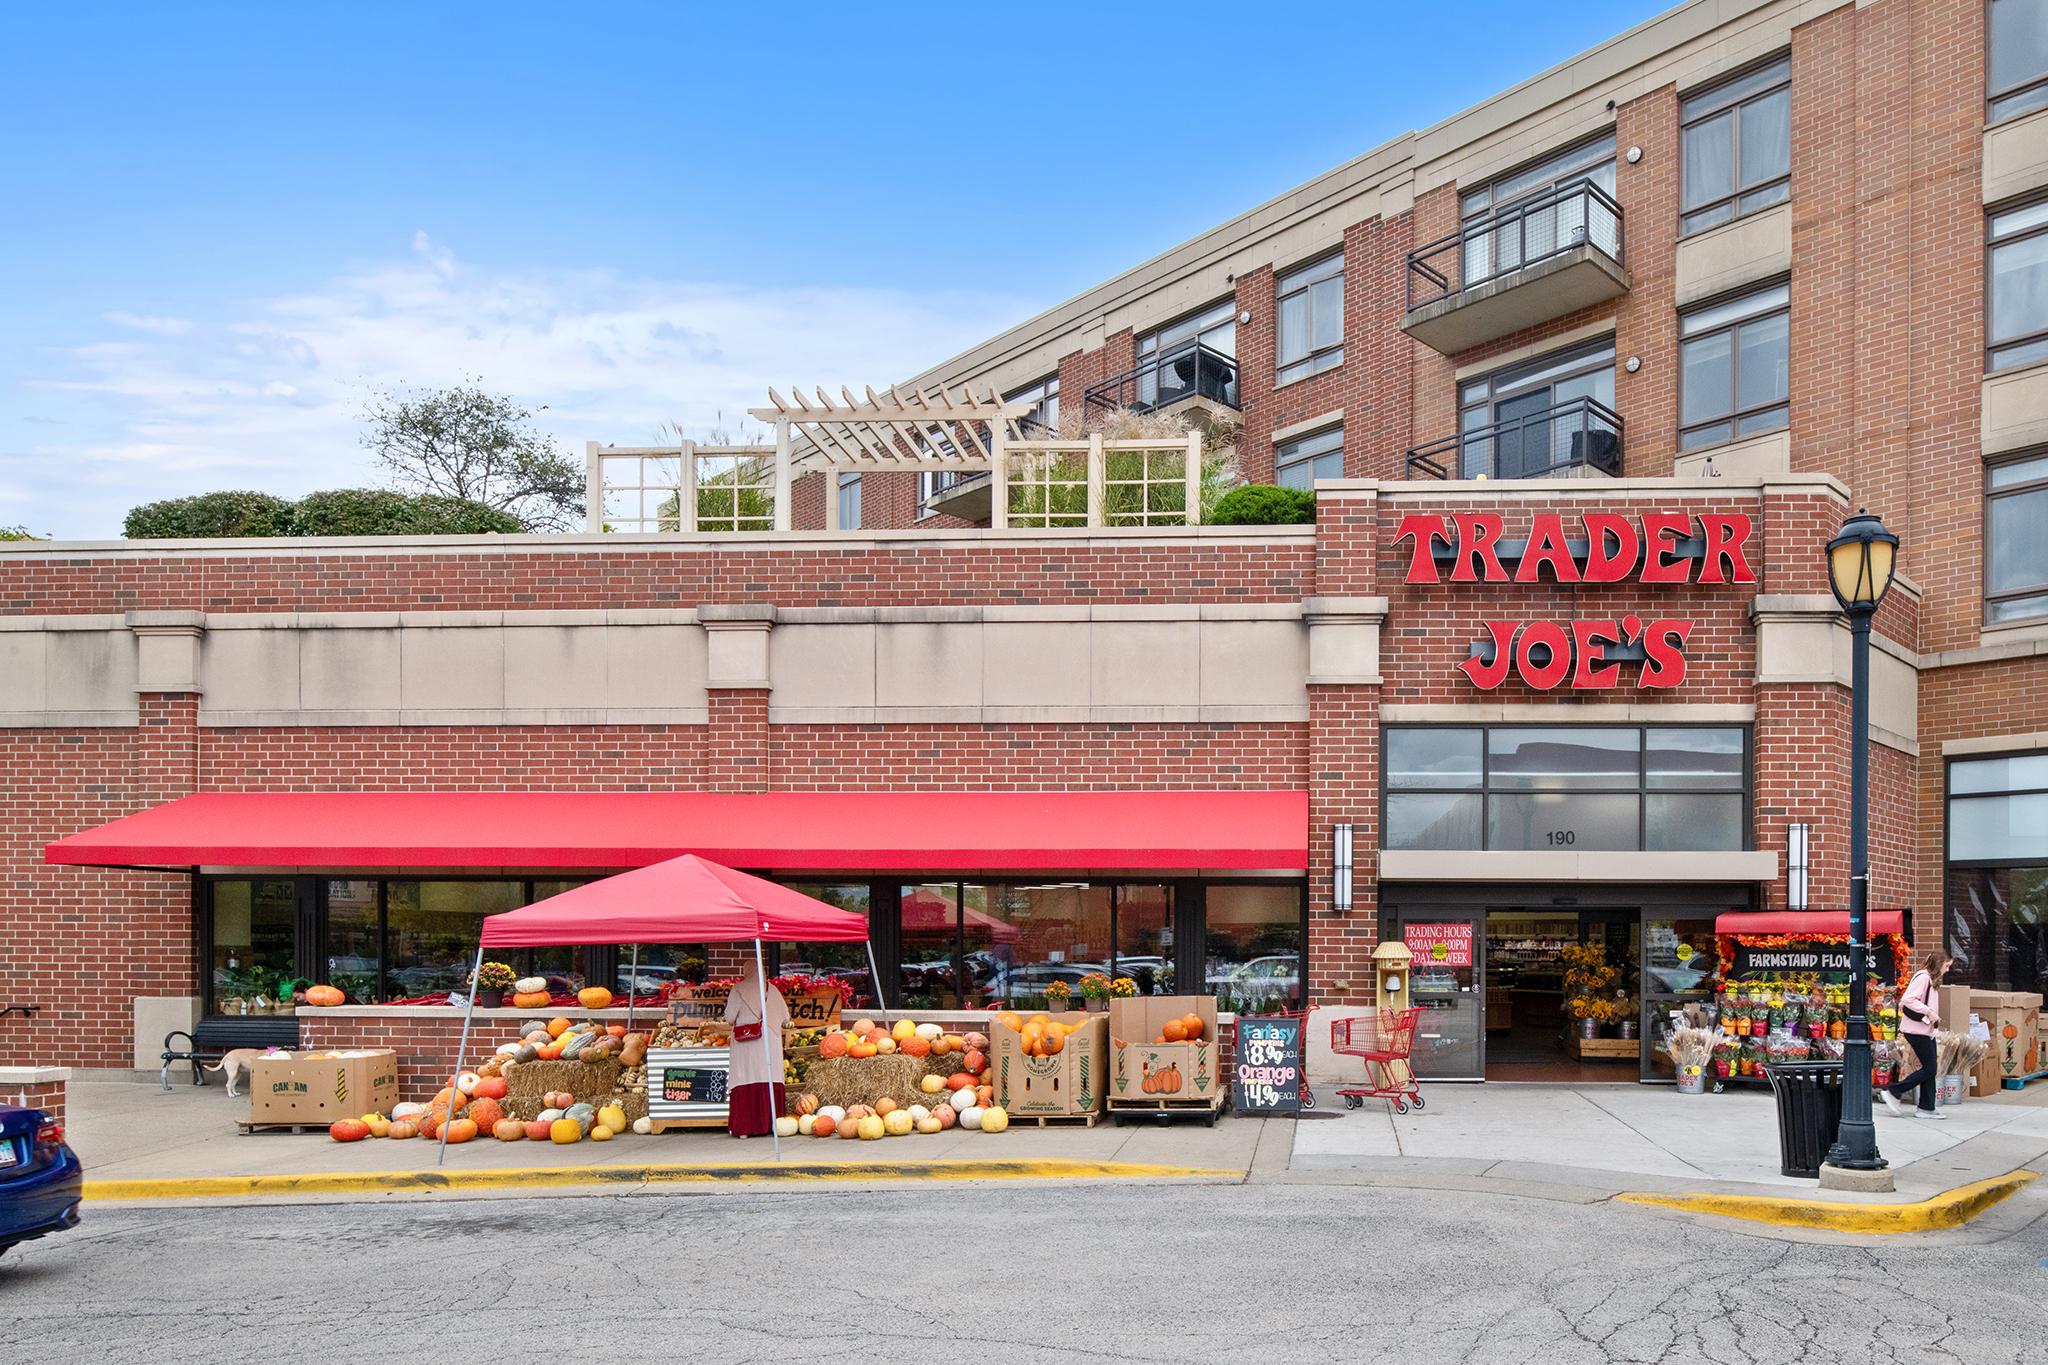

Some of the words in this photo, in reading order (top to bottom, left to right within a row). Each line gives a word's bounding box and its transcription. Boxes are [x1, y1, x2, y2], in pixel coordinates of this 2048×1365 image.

[1391, 513, 1758, 583] TRADER
[1457, 615, 1695, 690] JOE'S
[1546, 831, 1575, 845] 190
[1405, 927, 1442, 937] TRADING
[1443, 927, 1472, 937] HOURS
[1749, 954, 1818, 967] FARMSTAND
[1822, 954, 1877, 968] FLOWS
[1243, 1023, 1296, 1045] Fantasy
[1238, 1064, 1296, 1086] Orange
[294, 1082, 307, 1092] AM
[666, 1080, 692, 1088] minis
[665, 1089, 691, 1101] tiger
[1280, 1092, 1296, 1100] EACH
